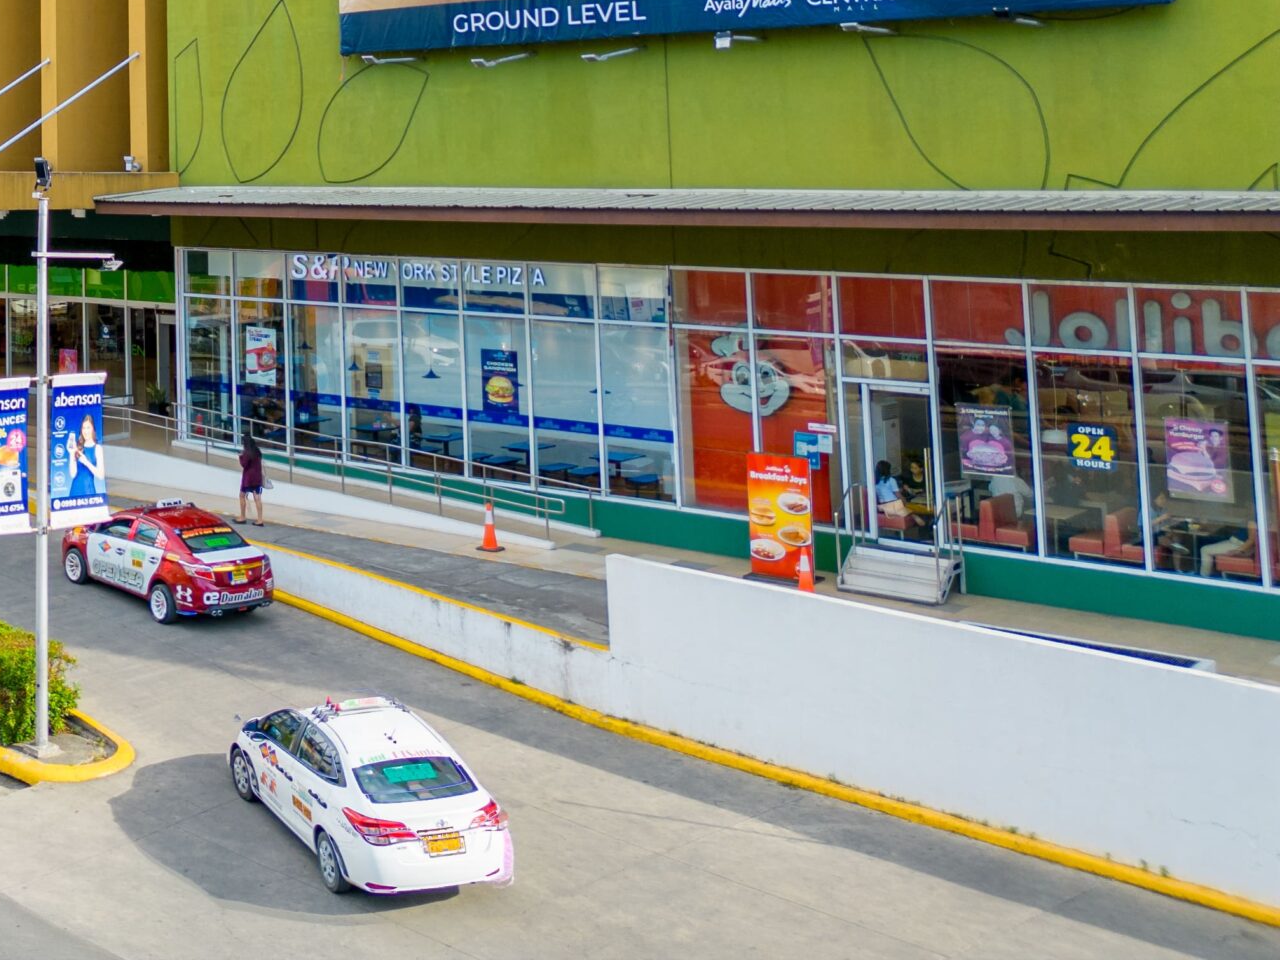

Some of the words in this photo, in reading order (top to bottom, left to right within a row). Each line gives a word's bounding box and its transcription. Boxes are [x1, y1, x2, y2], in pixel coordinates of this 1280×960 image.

[833, 3, 878, 13] MALL
[453, 7, 560, 34] GROUND
[566, 0, 647, 26] LEVEL
[353, 260, 388, 280] NEW
[391, 261, 436, 282] ORK
[496, 266, 547, 288] PIZA
[1004, 290, 1280, 361] Jollib
[54, 392, 101, 408] abenson
[1077, 426, 1104, 436] OPEN
[1071, 433, 1115, 462] 24
[1076, 458, 1111, 470] HOURS
[749, 470, 789, 483] Breakfast
[789, 476, 808, 486] Joys
